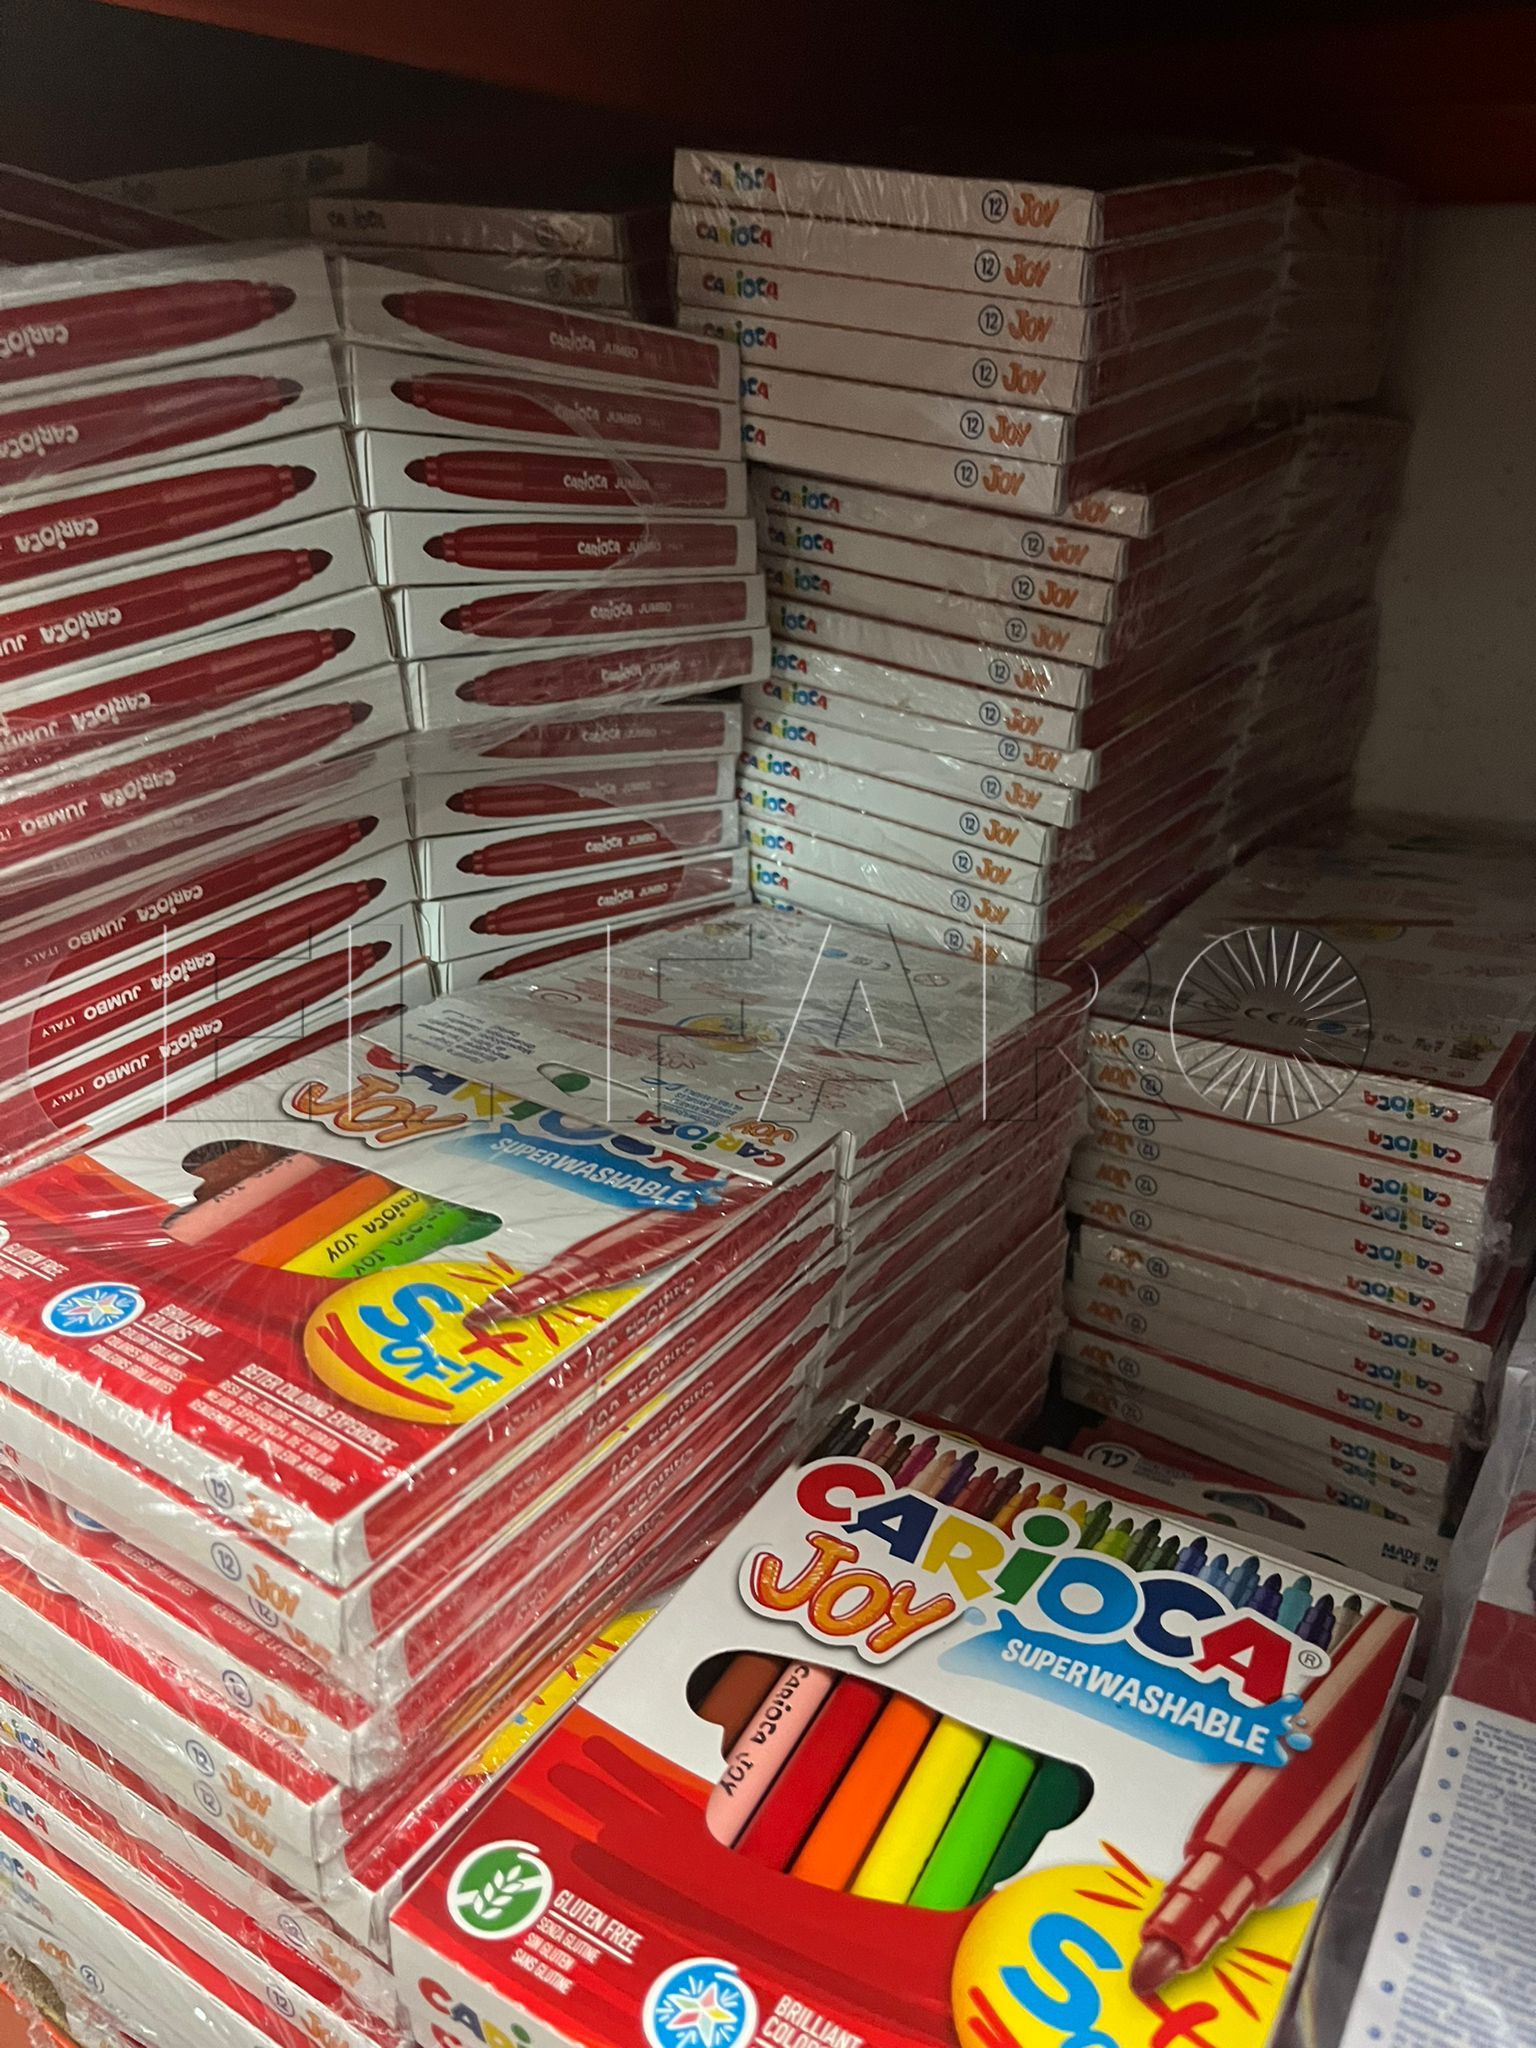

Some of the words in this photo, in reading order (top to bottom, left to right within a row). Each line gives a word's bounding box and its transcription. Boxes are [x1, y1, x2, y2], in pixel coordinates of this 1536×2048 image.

[67, 916, 126, 950] JUMBO
[41, 1016, 75, 1037] ITALY
[84, 985, 141, 1020] JUMBO
[92, 1053, 149, 1090] JUMBO
[50, 1087, 85, 1108] ITALY
[290, 1072, 468, 1144] JOY
[489, 1138, 691, 1205] SUPERWASHABLE
[246, 1564, 299, 1617] JOY
[750, 1529, 957, 1655] JOY
[1001, 1638, 1271, 1756] SUPERWASHABLE
[719, 1752, 753, 1797] JOY
[553, 1889, 608, 1932] GLUTEN
[601, 1918, 645, 1955] FREE
